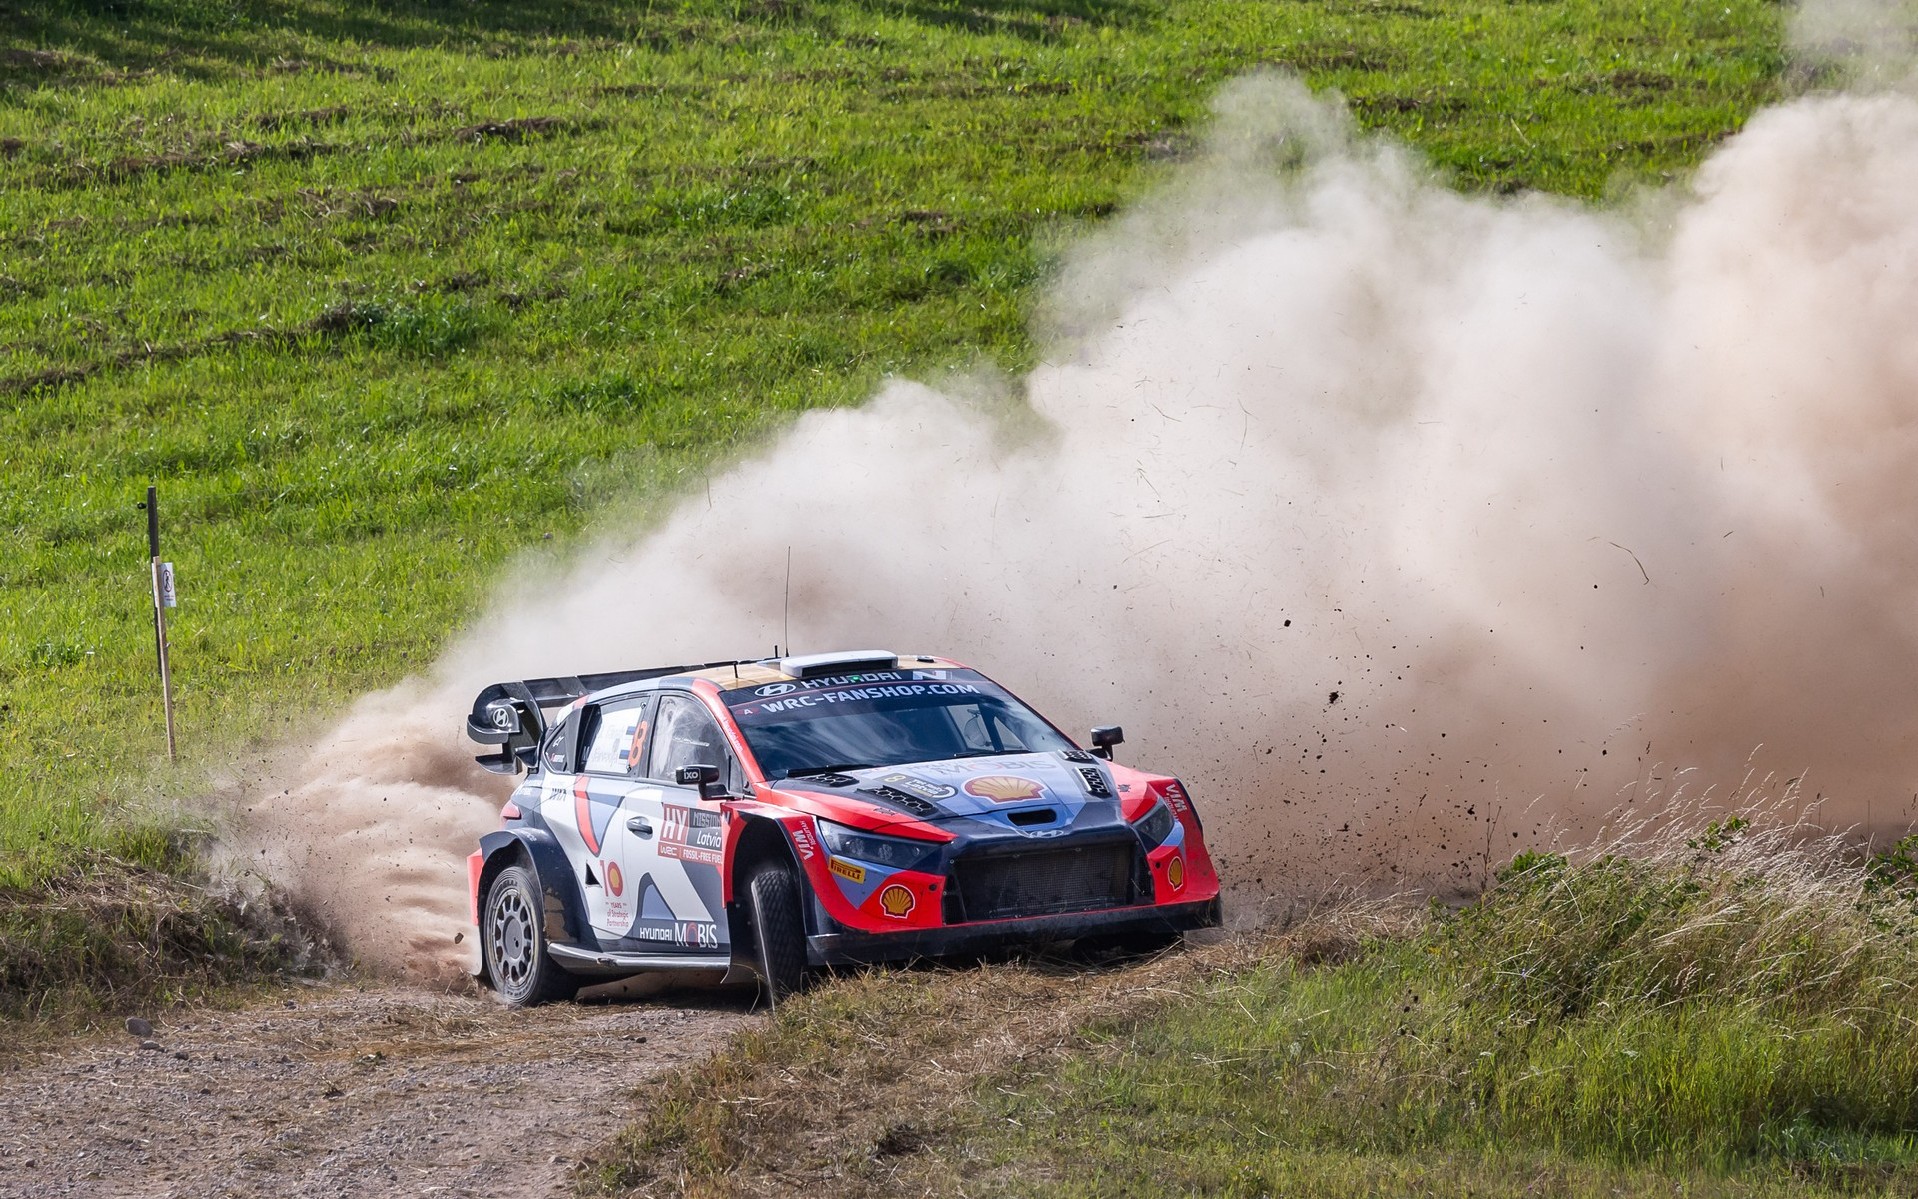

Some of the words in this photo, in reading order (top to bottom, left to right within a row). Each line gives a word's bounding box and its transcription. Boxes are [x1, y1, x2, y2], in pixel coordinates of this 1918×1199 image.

[761, 684, 981, 713] WRC-FANSHOP.COM
[627, 720, 648, 767] 8
[662, 807, 688, 841] HY
[696, 830, 721, 848] Latvia
[830, 858, 862, 880] PIRELLI
[639, 927, 673, 941] HYUNDAI
[674, 922, 719, 949] MOBIS
